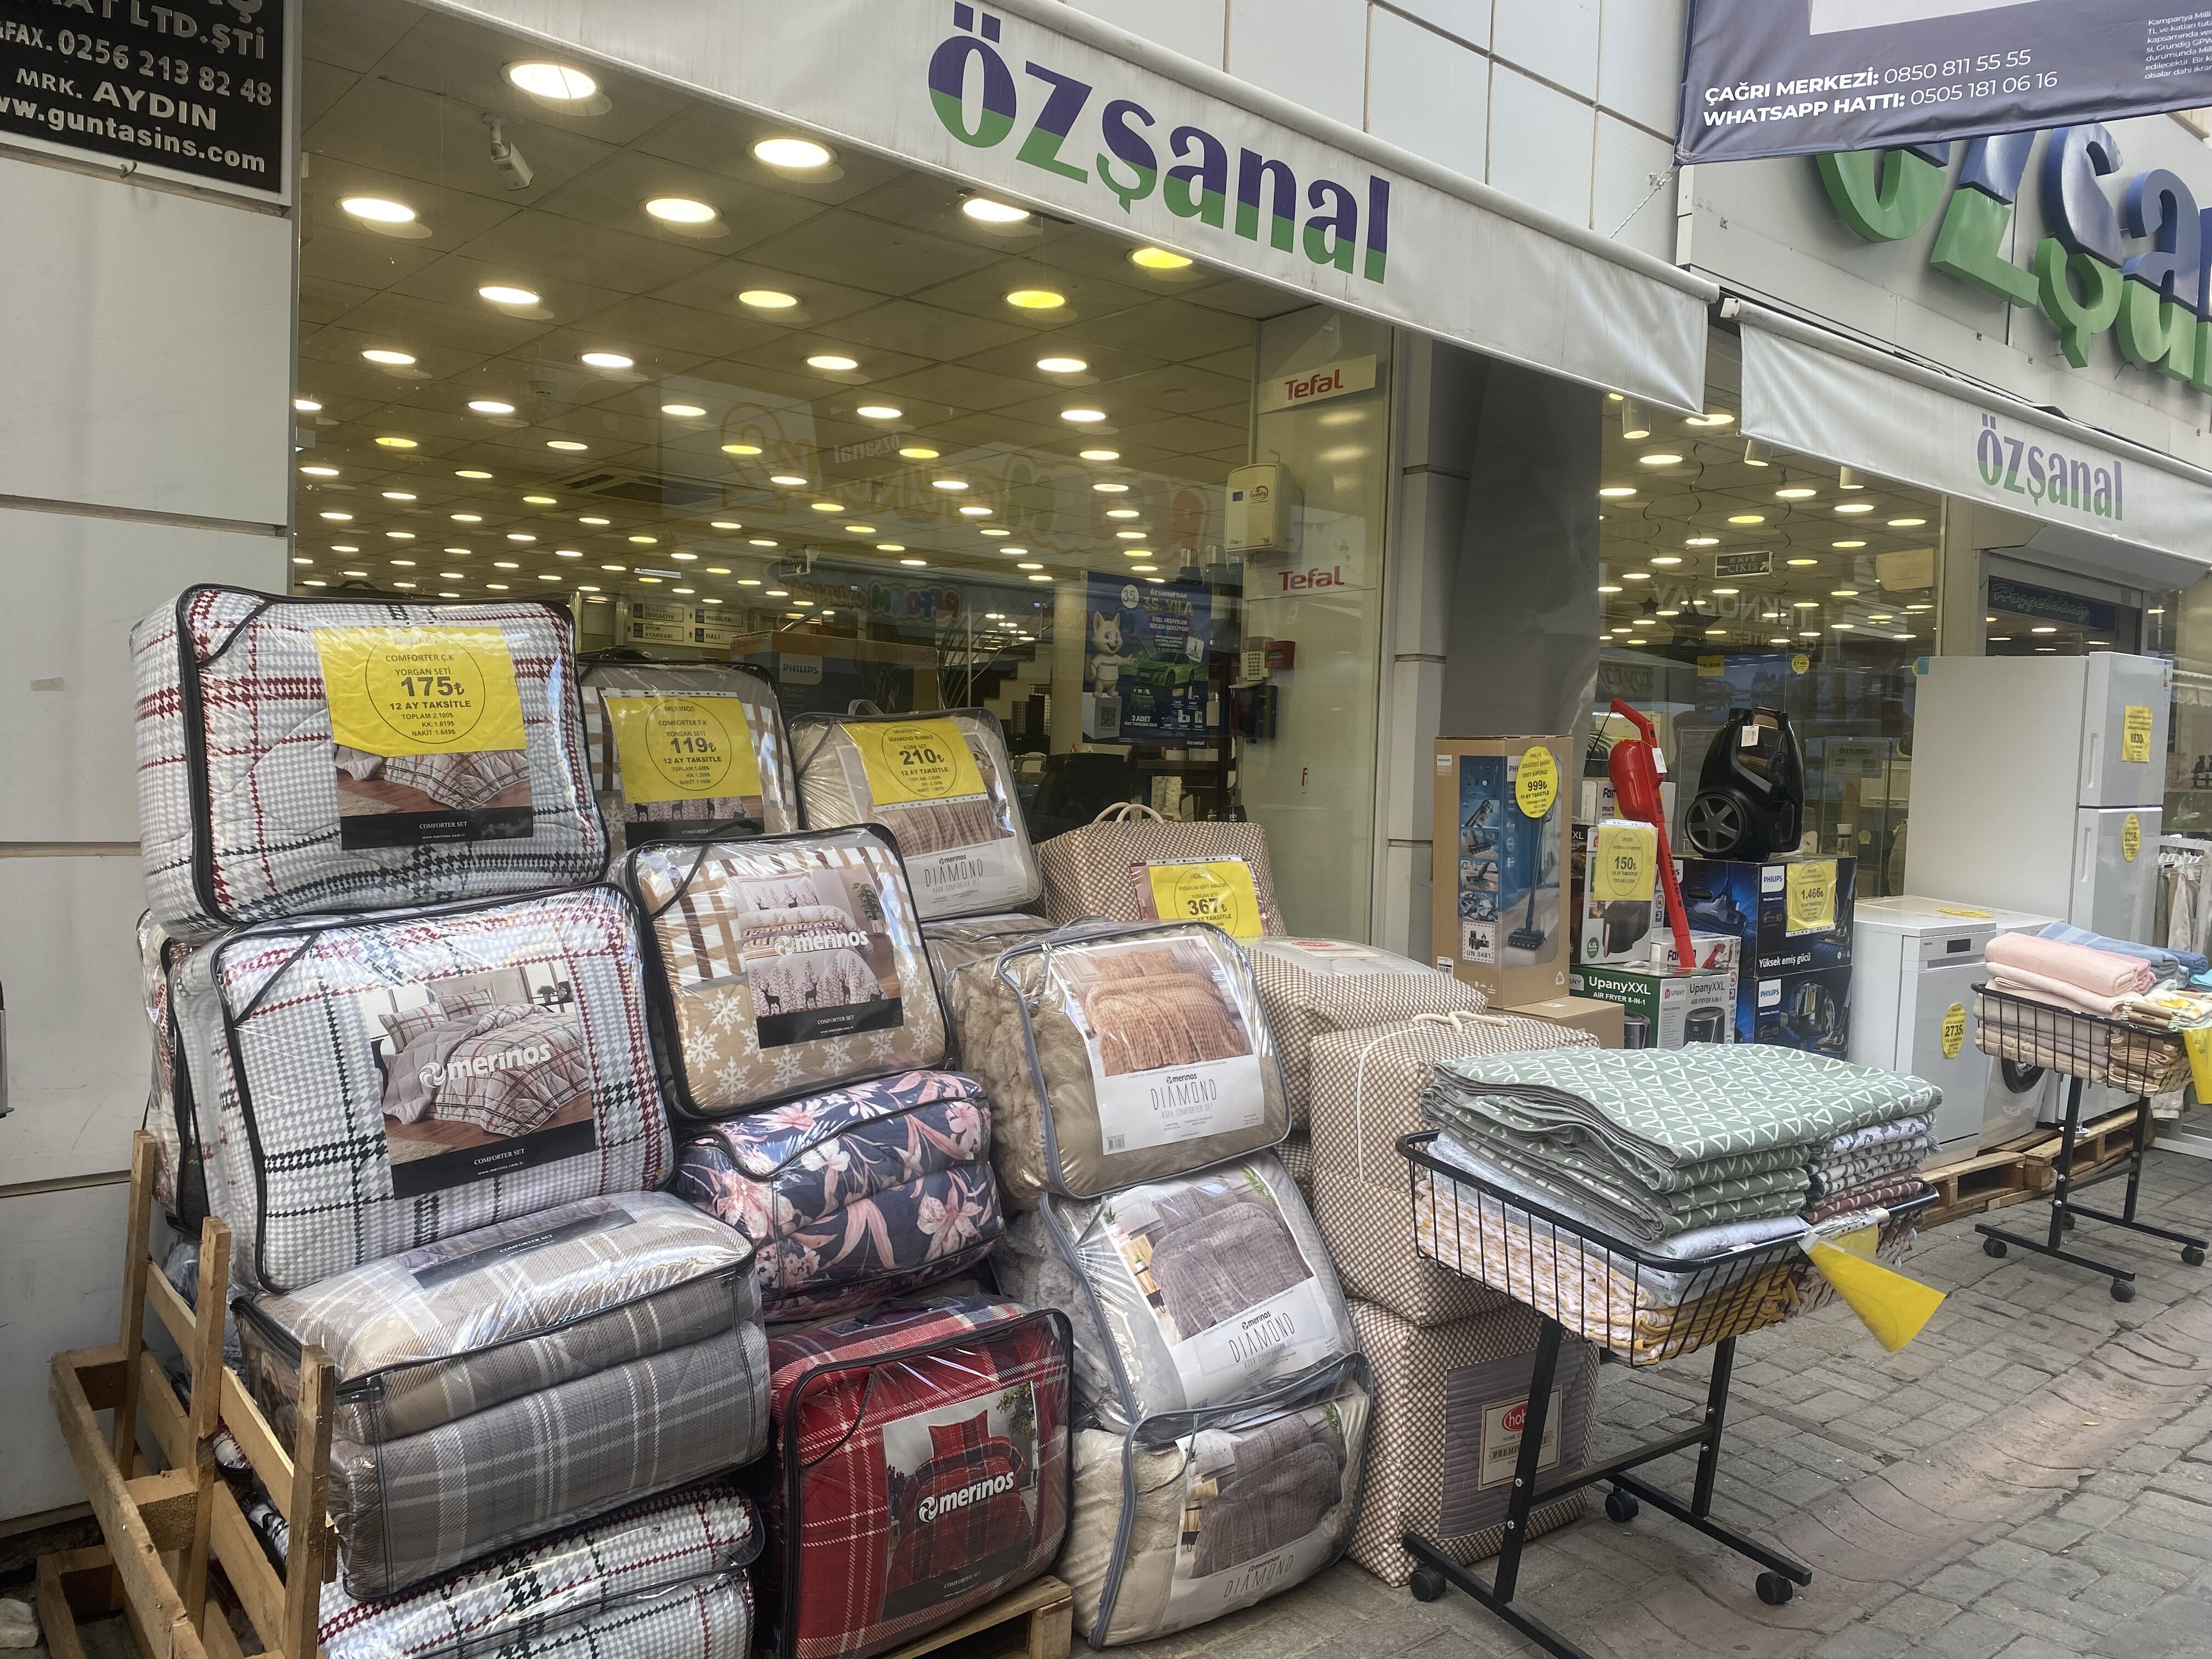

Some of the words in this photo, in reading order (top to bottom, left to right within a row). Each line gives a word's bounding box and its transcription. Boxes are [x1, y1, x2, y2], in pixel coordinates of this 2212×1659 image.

[2148, 14, 2193, 26] Kampanya
[2157, 41, 2191, 51] Grundig
[2146, 49, 2197, 61] durumunda
[0, 20, 52, 51] FAX.
[58, 30, 129, 70] 0256
[139, 50, 189, 84] 213
[199, 66, 230, 97] 82
[240, 78, 272, 106] 48
[1705, 82, 1771, 106] ÇAĞRI
[1771, 66, 1880, 98] MERKEZİ:
[1884, 63, 1937, 84] 0850
[1942, 58, 1971, 76] 811
[1975, 53, 2001, 72] 55
[2006, 49, 2032, 67] 55
[2145, 70, 2171, 79] olsalar
[16, 68, 82, 99] MRK.
[92, 81, 216, 131] AYDIN
[1703, 101, 1829, 127] WHATSAPP
[1833, 91, 1906, 115] HATTI:
[1911, 86, 1963, 106] 0505
[1967, 80, 1996, 99] 181
[2002, 75, 2032, 94] 06
[2036, 71, 2058, 89] 16
[1285, 369, 1344, 400] Tefal
[1278, 566, 1345, 591] Tefal
[441, 654, 454, 662] Ç.K
[434, 667, 451, 675] SETİ
[783, 663, 819, 674] PHILIPS
[422, 699, 472, 708] TAKSİTLE
[419, 821, 456, 830] COMFORTER
[944, 854, 967, 864] merinos
[924, 859, 983, 887] DIAMOND
[1763, 875, 1782, 883] PHILIPS
[795, 930, 868, 953] merinos
[1477, 950, 1491, 958] 3481
[1759, 957, 1781, 968] Yüksek
[1782, 956, 1796, 966] emiş
[1797, 952, 1811, 964] gücü
[1589, 976, 1651, 995] UpanyXXL
[1690, 981, 1725, 995] UpanyXXL
[1760, 988, 1780, 998] PHILIPS
[1605, 993, 1627, 1002] FRYER
[1628, 996, 1646, 1006] 8-IN-1
[817, 1015, 845, 1025] COMFORTER
[445, 1043, 551, 1082] merinos
[1172, 1073, 1197, 1084] merinos
[1151, 1079, 1217, 1110] DIAMOND
[474, 1150, 512, 1165] COMFORTER
[513, 1148, 525, 1157] SET
[499, 1238, 540, 1253] COMFORTER
[1247, 1311, 1271, 1327] merinos
[1228, 1312, 1295, 1363] DIAMOND
[939, 1471, 1014, 1515] merinos
[944, 1574, 973, 1589] COMFORTER
[1223, 1555, 1294, 1598] DIAMOND
